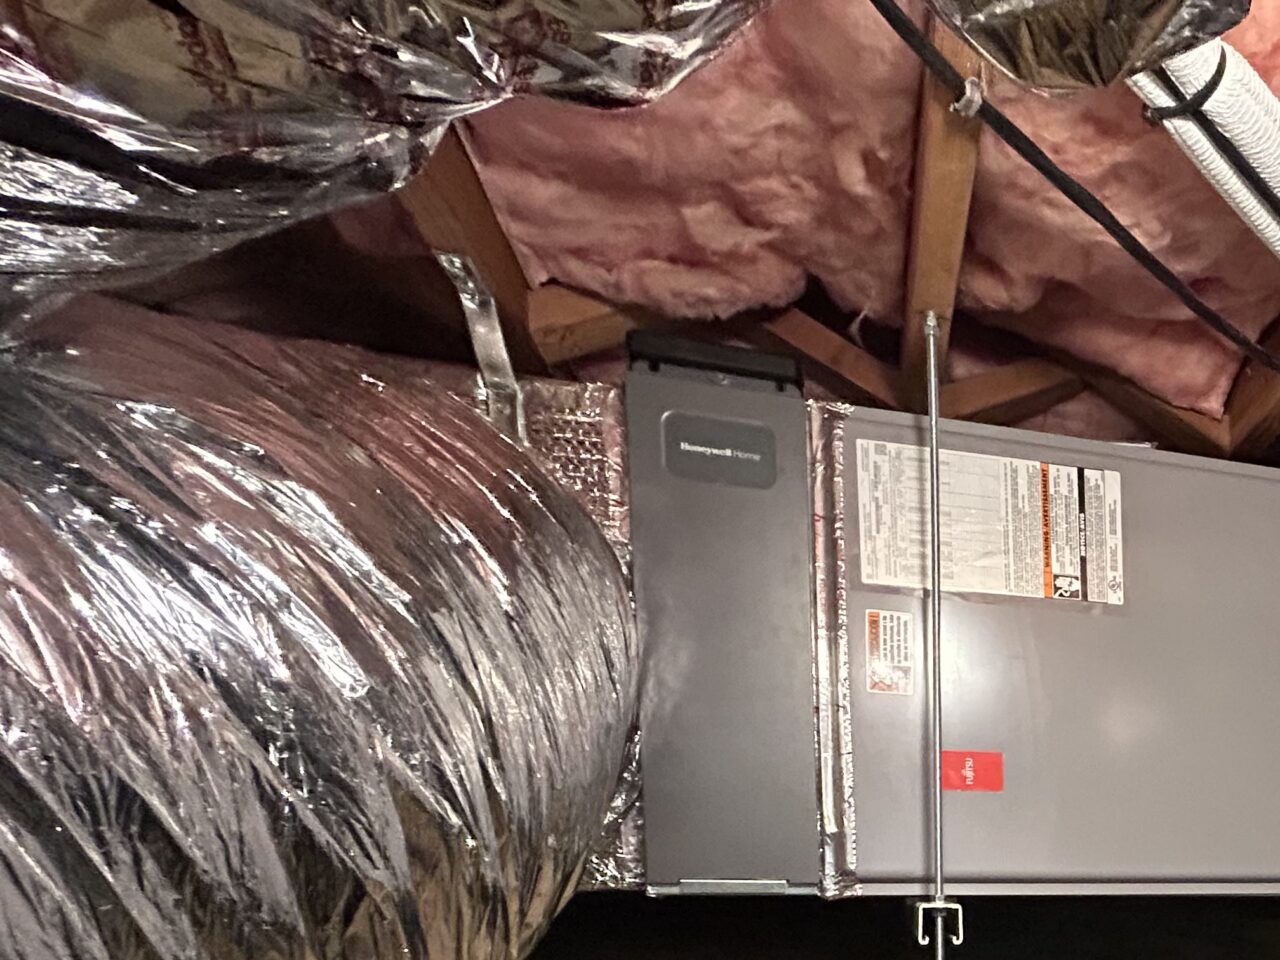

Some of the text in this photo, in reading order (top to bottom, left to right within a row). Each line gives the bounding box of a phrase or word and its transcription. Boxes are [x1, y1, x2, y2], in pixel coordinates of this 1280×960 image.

[681, 442, 761, 461] Honeywell Home
[962, 757, 975, 785] FUJITSU
